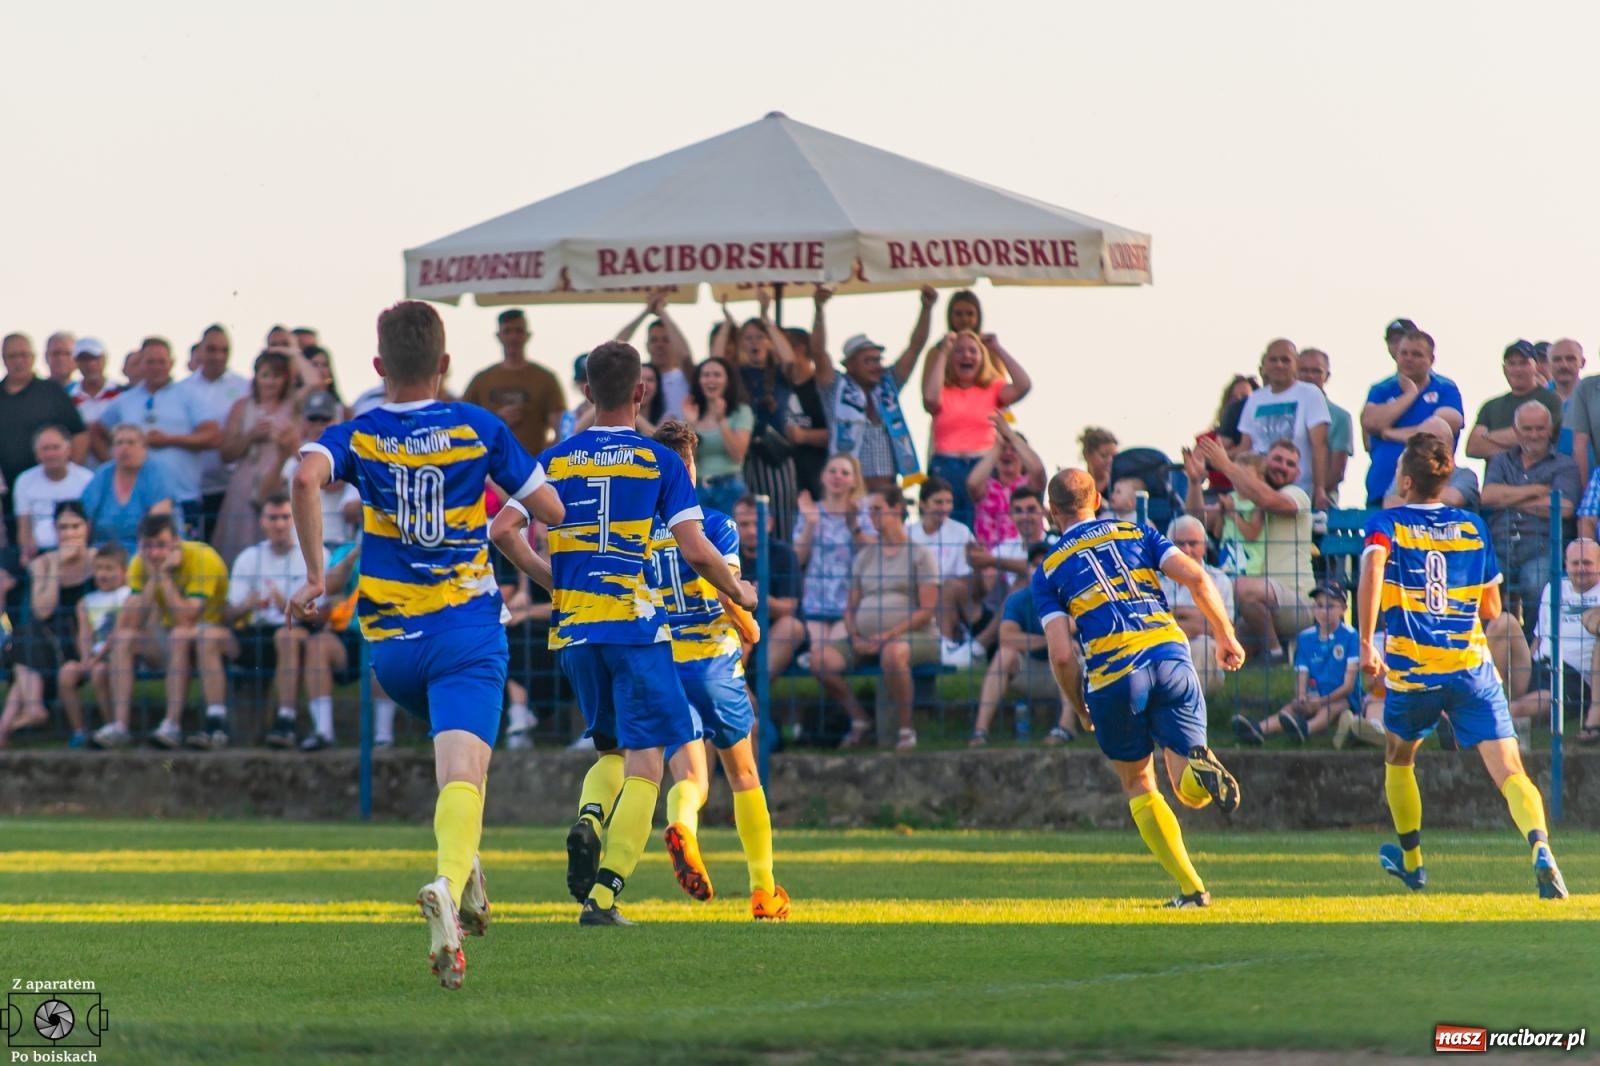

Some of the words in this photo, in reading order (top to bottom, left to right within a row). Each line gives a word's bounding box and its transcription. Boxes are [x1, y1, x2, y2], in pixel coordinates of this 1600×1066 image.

[418, 251, 544, 287] RACIBORSKIE
[597, 241, 824, 276] RACIBORSKIE
[887, 239, 1079, 270] RACIBORSKIE
[389, 463, 445, 548] 10
[587, 477, 611, 554] 7
[1075, 540, 1141, 602] 17
[1425, 550, 1448, 615] 8
